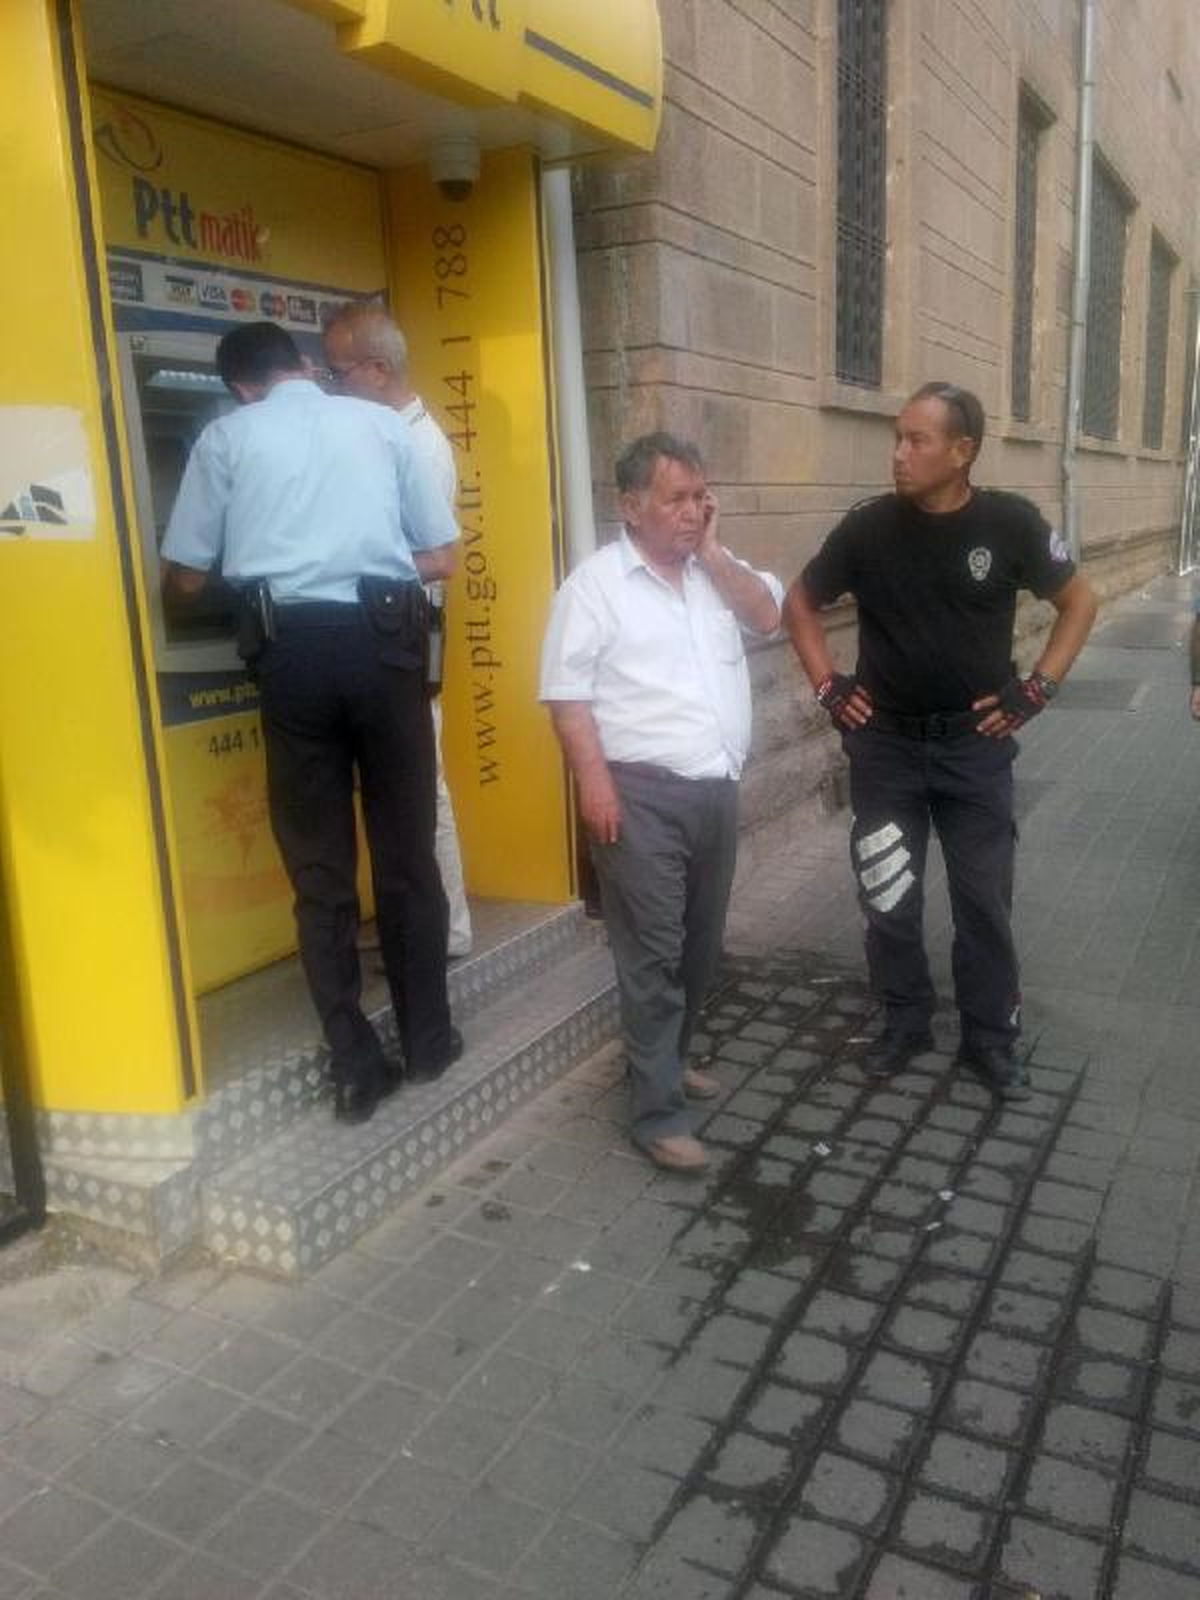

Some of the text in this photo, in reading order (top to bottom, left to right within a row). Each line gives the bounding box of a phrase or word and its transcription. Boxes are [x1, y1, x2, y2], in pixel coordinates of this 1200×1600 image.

[432, 223, 471, 311] 788
[442, 371, 477, 452] 444
[209, 730, 243, 757] 444
